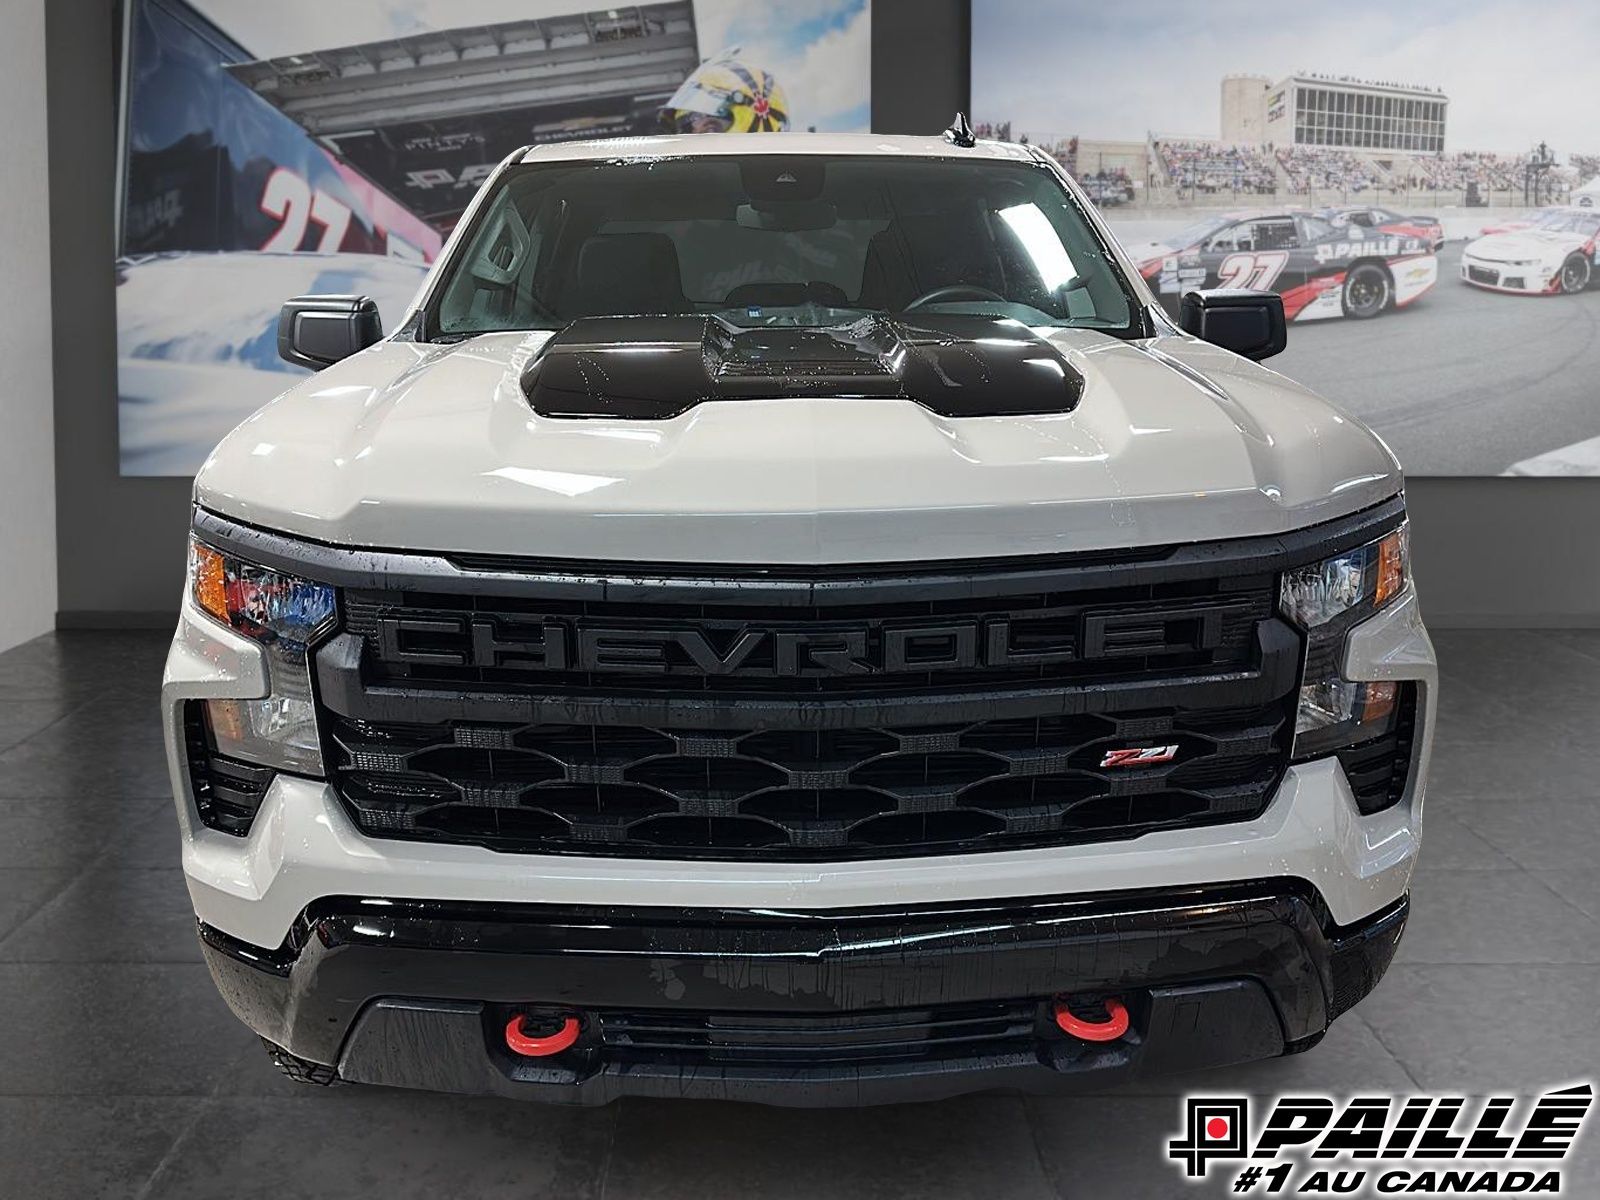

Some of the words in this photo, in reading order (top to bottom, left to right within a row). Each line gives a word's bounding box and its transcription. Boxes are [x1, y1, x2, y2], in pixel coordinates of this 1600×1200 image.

[260, 166, 352, 253] 27
[1217, 250, 1289, 291] 27
[377, 603, 1253, 676] CHEVROLET
